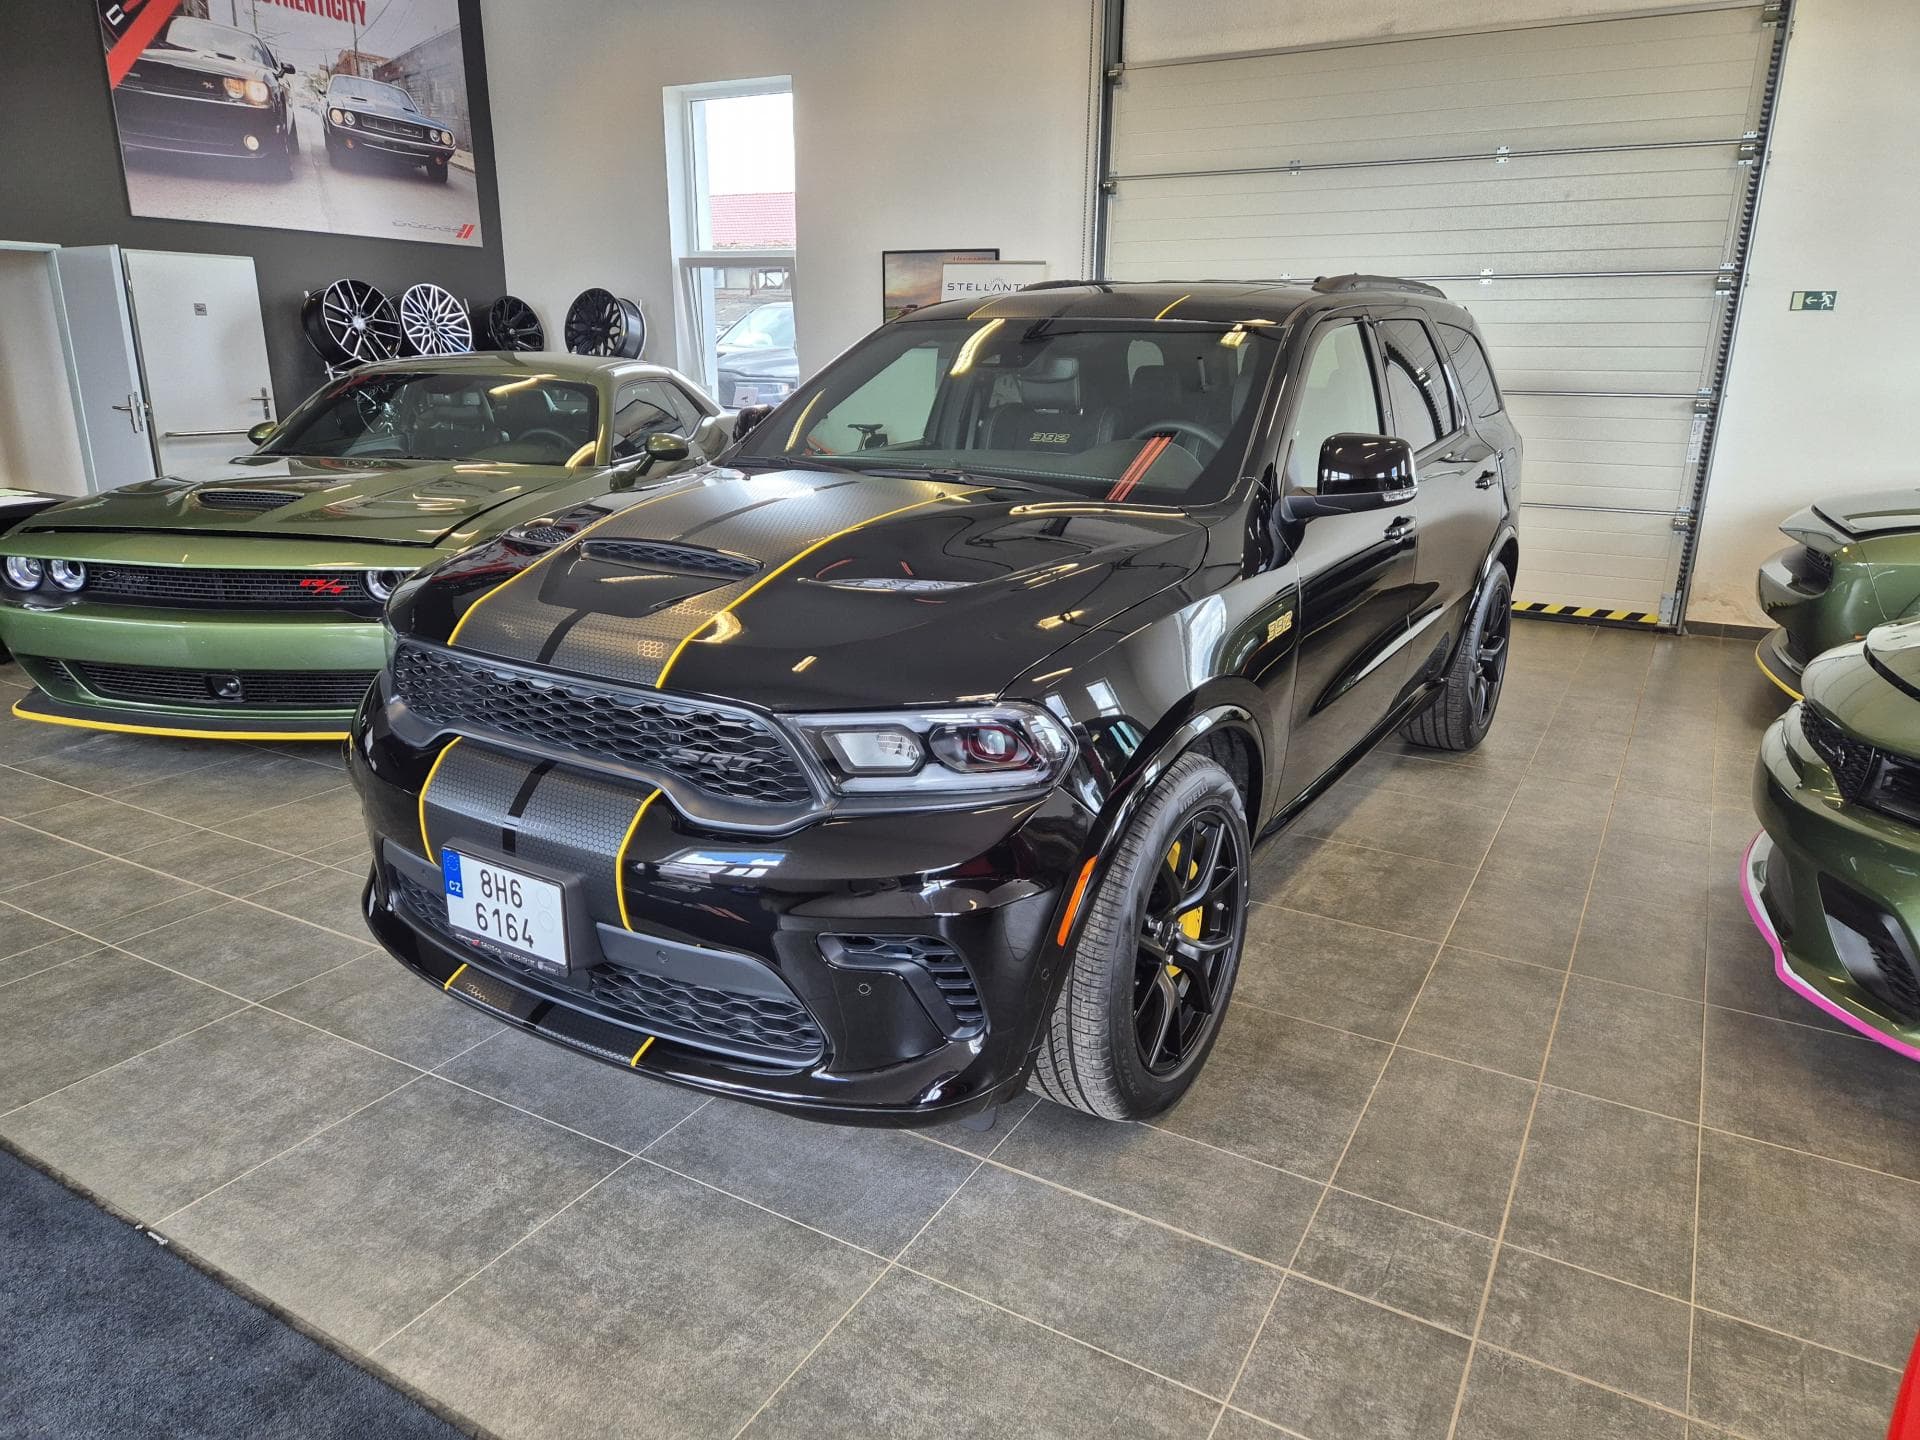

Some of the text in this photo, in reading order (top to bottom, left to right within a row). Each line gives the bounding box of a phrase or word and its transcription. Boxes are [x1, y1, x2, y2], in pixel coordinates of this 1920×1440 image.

[254, 0, 366, 26] NTICITY
[947, 282, 1027, 292] STELLANTI
[1029, 432, 1071, 443] 392
[300, 579, 349, 594] R/T
[448, 880, 463, 893] CZ
[480, 869, 523, 909] 8H6
[475, 902, 534, 949] 6164
